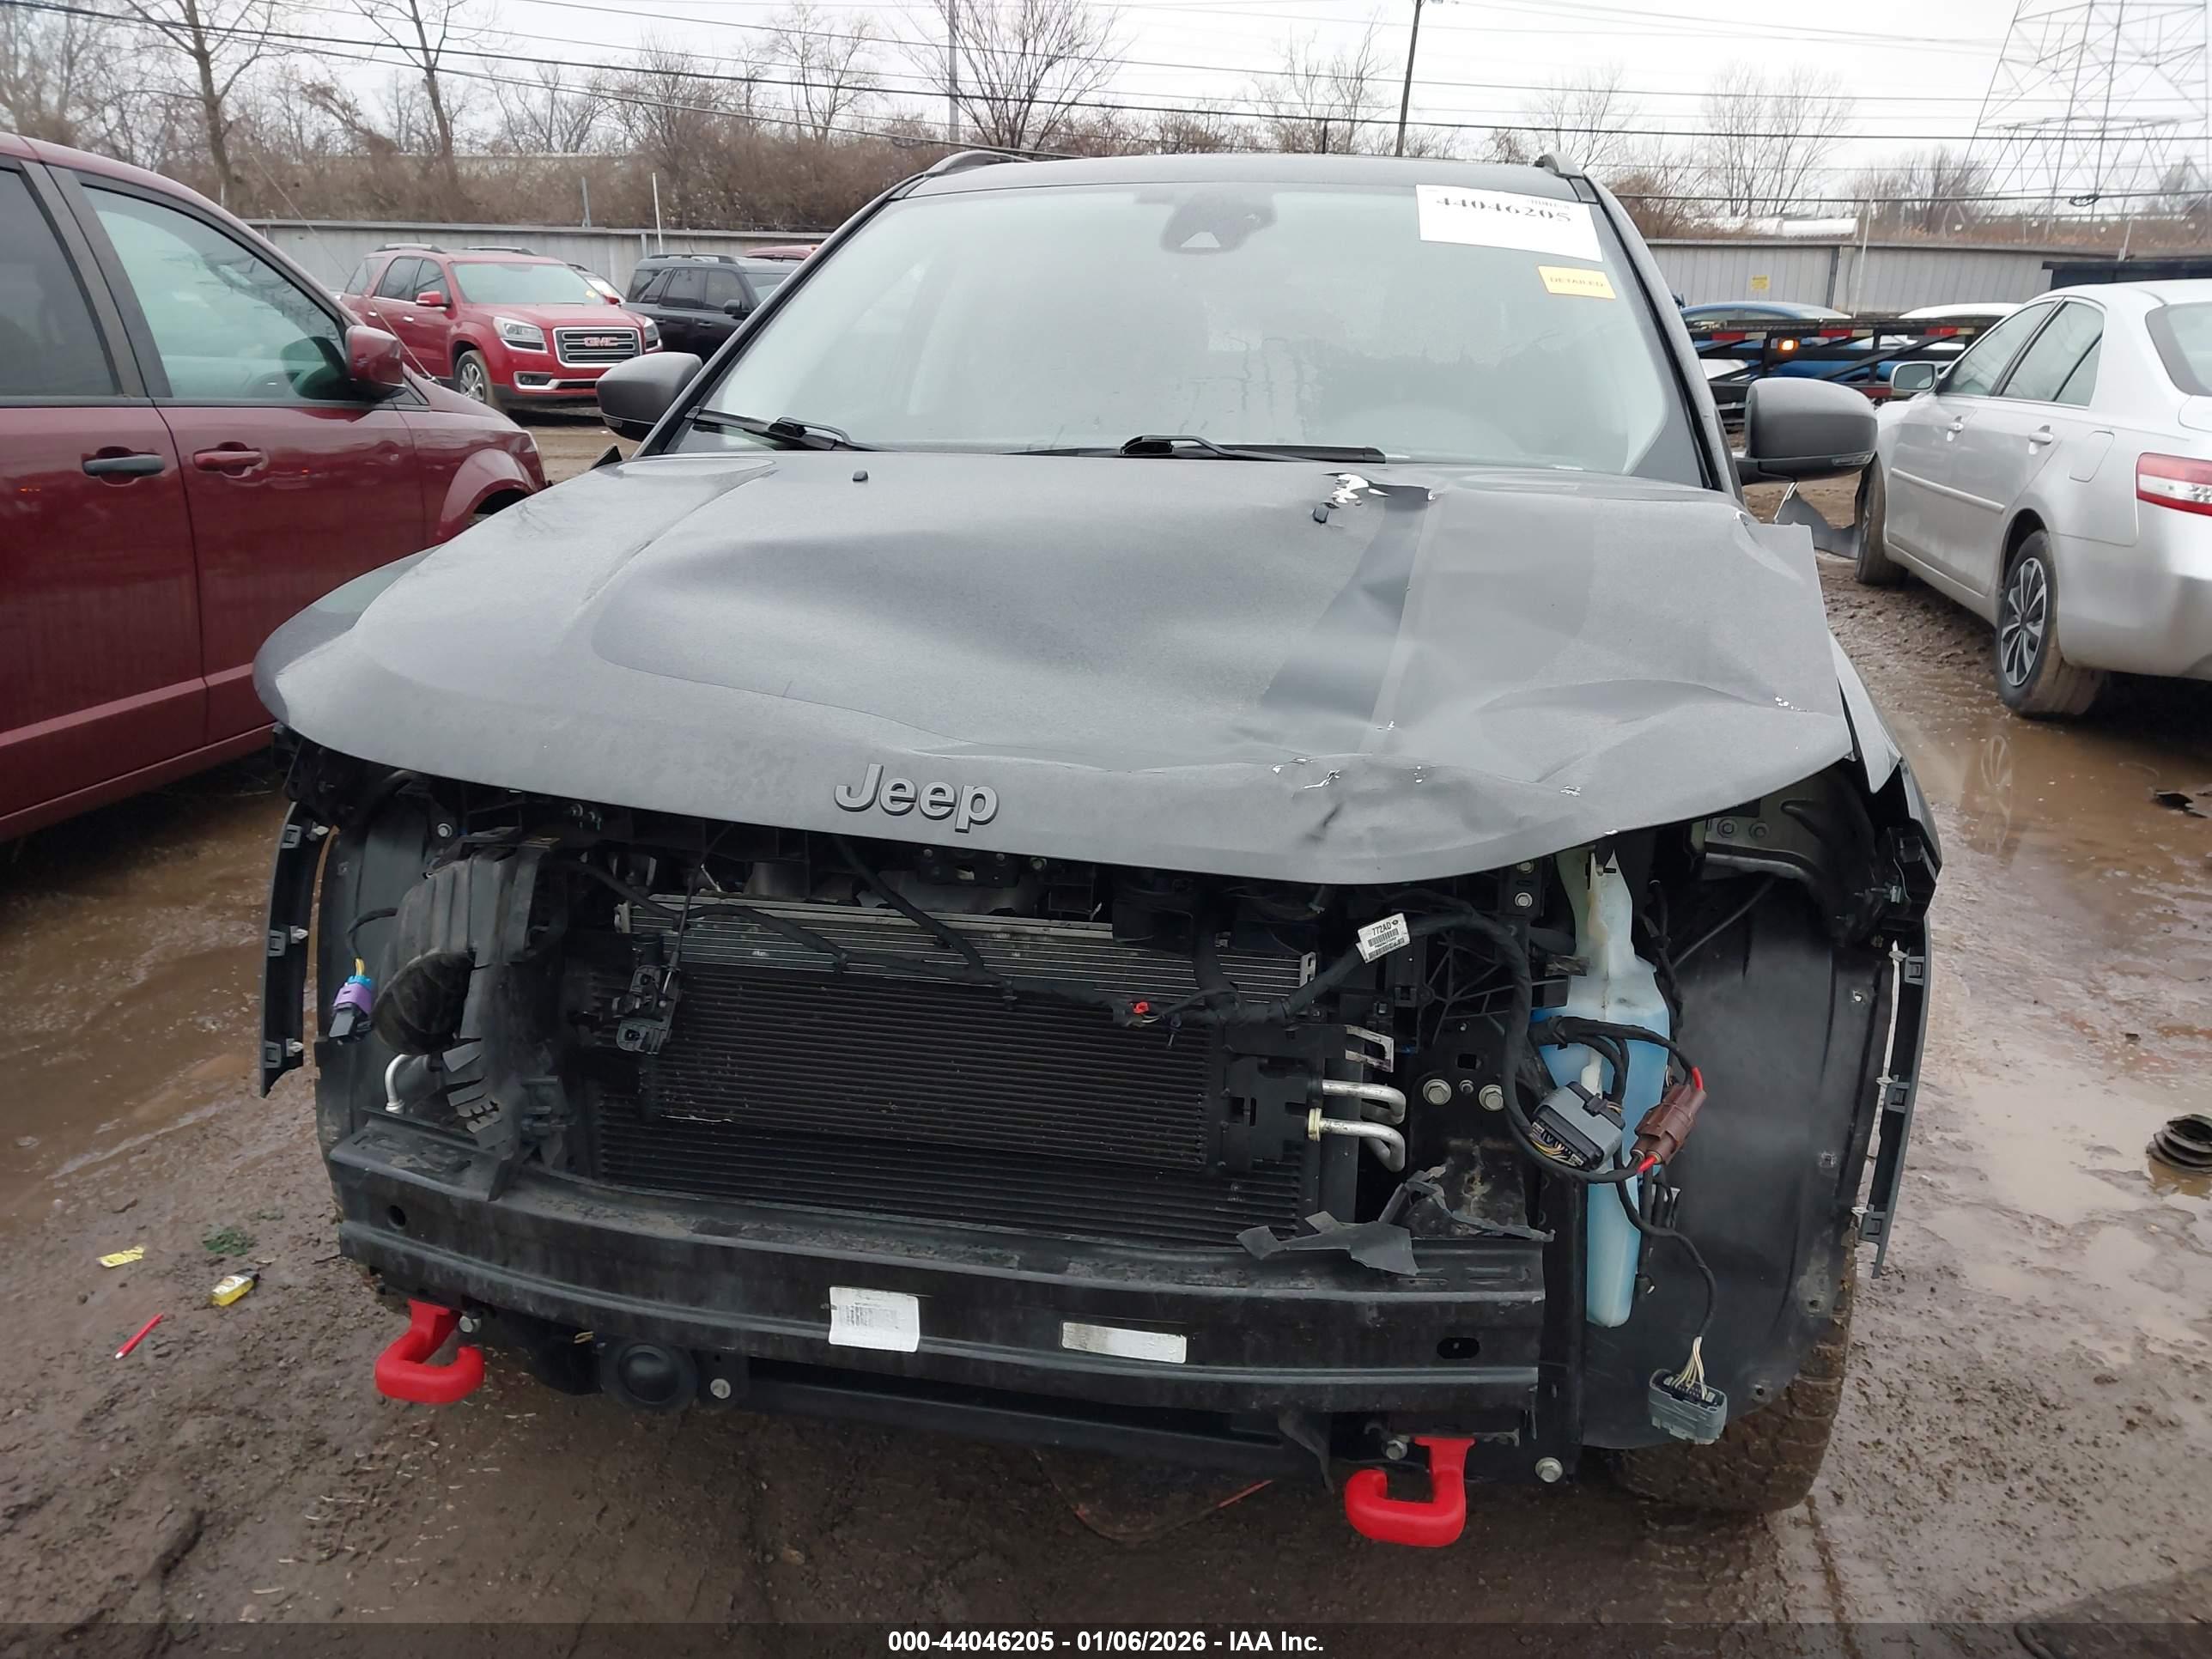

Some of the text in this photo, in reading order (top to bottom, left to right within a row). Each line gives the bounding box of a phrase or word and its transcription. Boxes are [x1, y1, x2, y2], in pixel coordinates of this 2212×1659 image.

[584, 337, 618, 347] GMC
[834, 763, 999, 833] Jeep
[1372, 921, 1392, 936] 772AD
